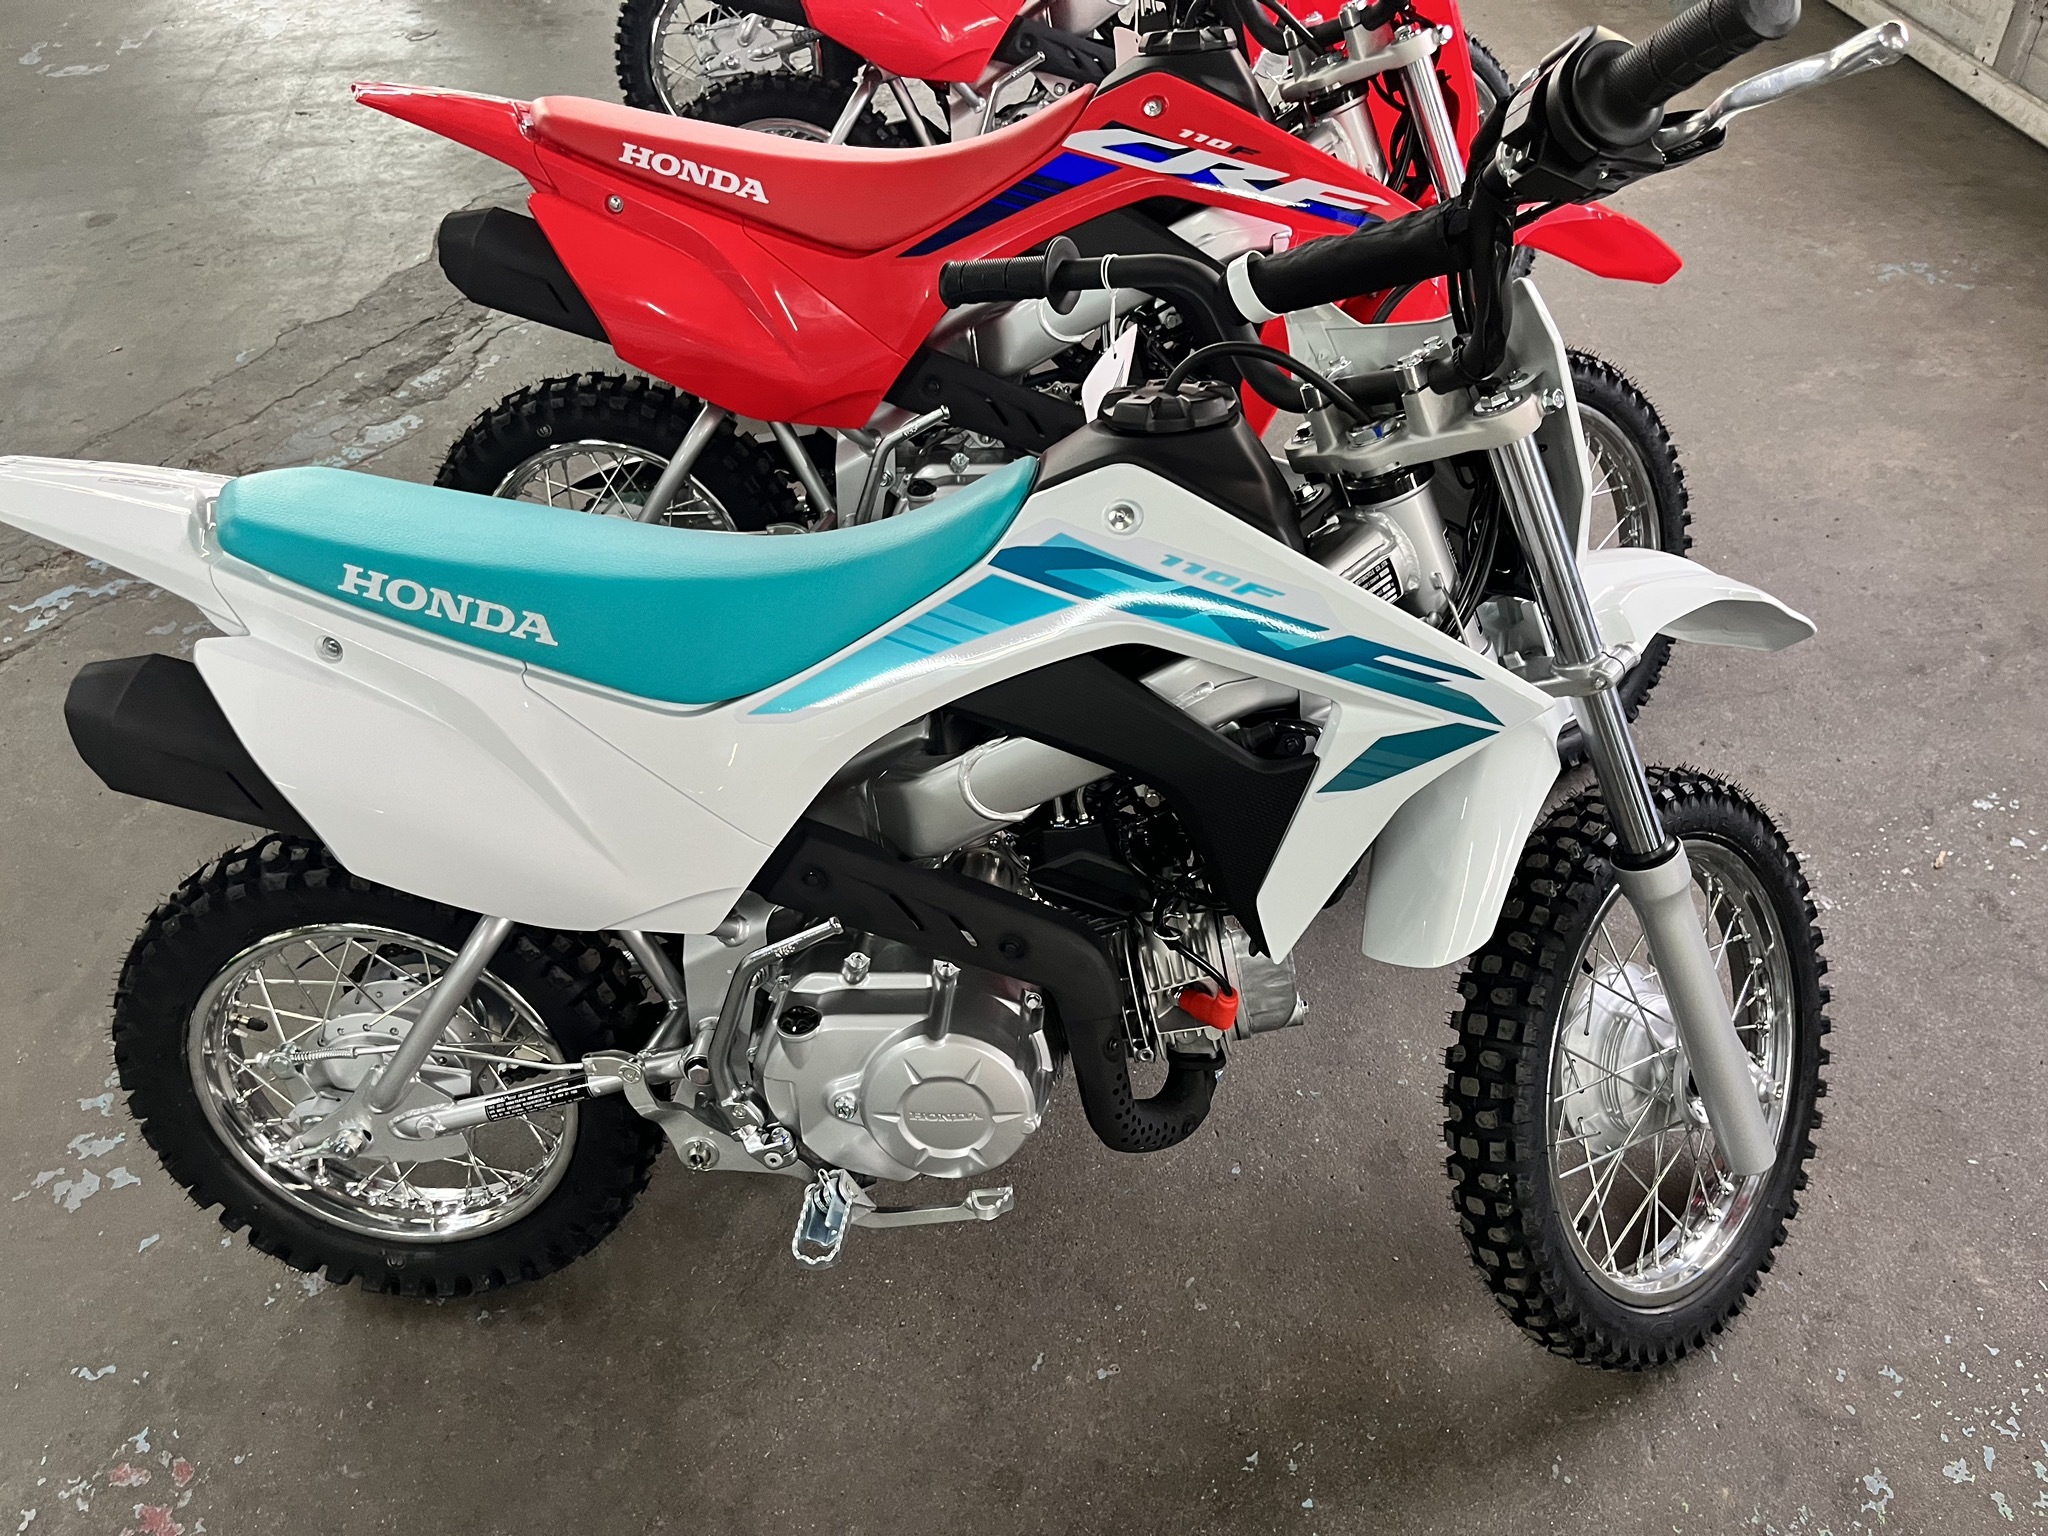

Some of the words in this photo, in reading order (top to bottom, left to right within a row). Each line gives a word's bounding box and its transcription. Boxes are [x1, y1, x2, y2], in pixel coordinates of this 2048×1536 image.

[1062, 128, 1390, 210] CRF
[1178, 128, 1261, 155] 110F
[618, 142, 770, 205] HONDA
[337, 563, 559, 647] HONDA
[1160, 553, 1286, 597] 110F
[988, 545, 1486, 682] CRF
[909, 1111, 984, 1122] HONDA
